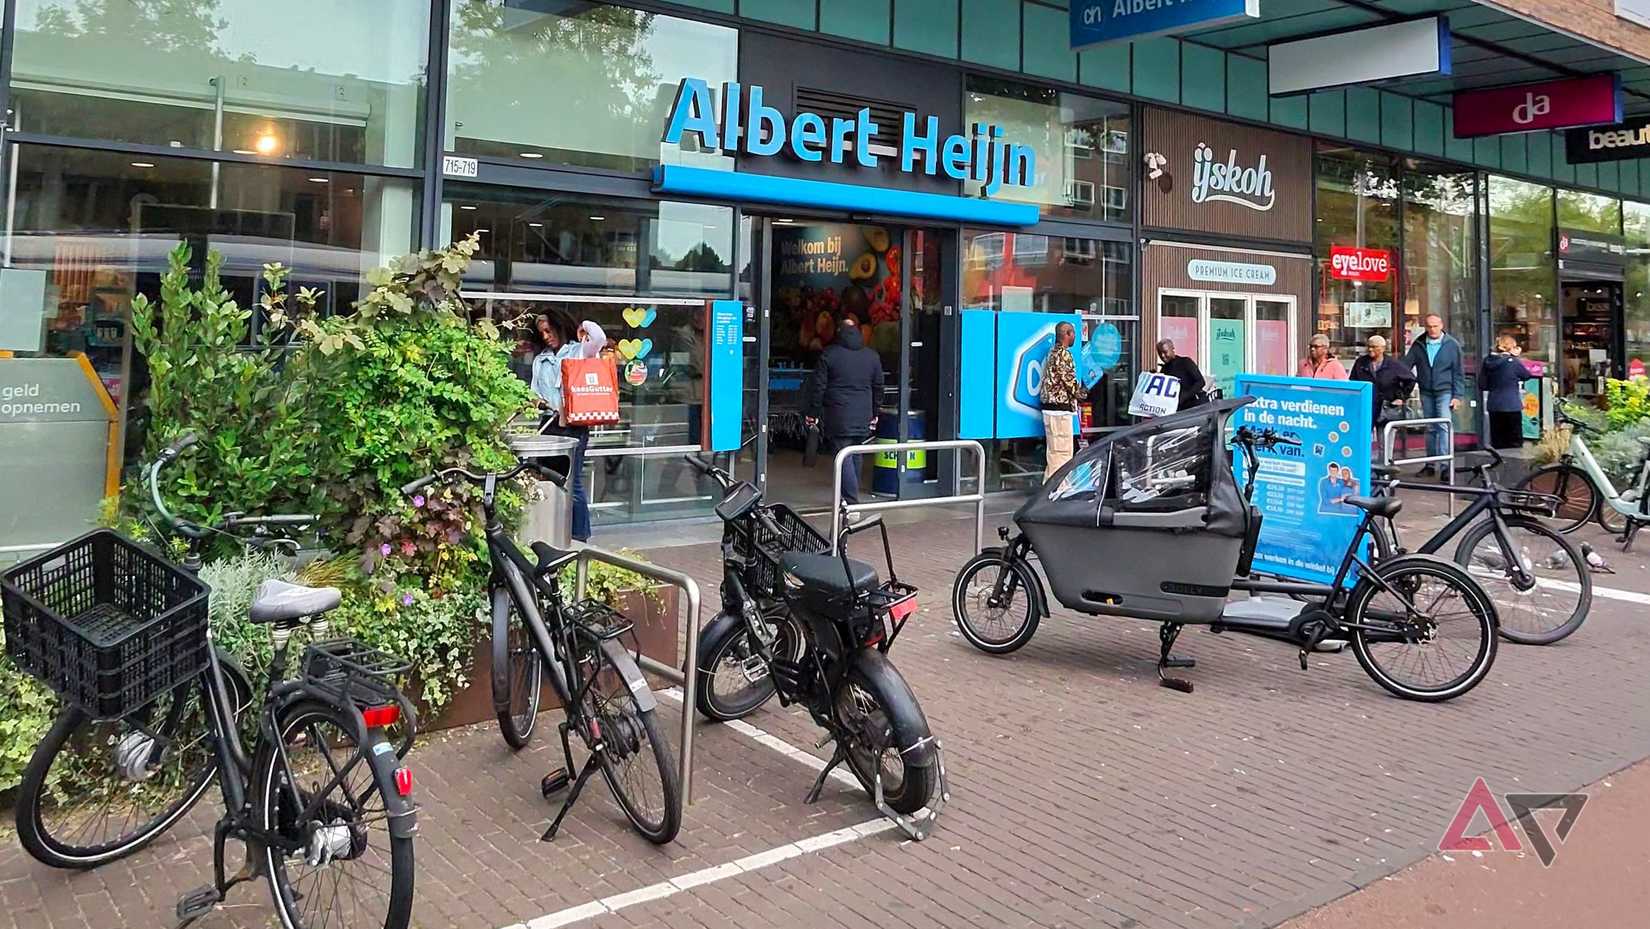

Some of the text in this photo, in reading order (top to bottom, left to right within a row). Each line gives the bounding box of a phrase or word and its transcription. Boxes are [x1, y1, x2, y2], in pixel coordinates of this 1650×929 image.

[1512, 92, 1550, 124] da
[664, 77, 1037, 199] Albert Heijn
[445, 159, 476, 175] 715-719
[827, 236, 842, 256] bij
[817, 256, 849, 276] Heijn.
[1195, 265, 1270, 280] PREMIUM ICE CREAM
[1332, 252, 1388, 276] eyelove
[2, 384, 40, 401] geld
[1, 402, 81, 417] opnemen
[1139, 403, 1167, 415] ACTION
[1244, 396, 1345, 417] xtra verdienen
[1244, 408, 1318, 429] in de nacht.
[1280, 445, 1305, 457] van.
